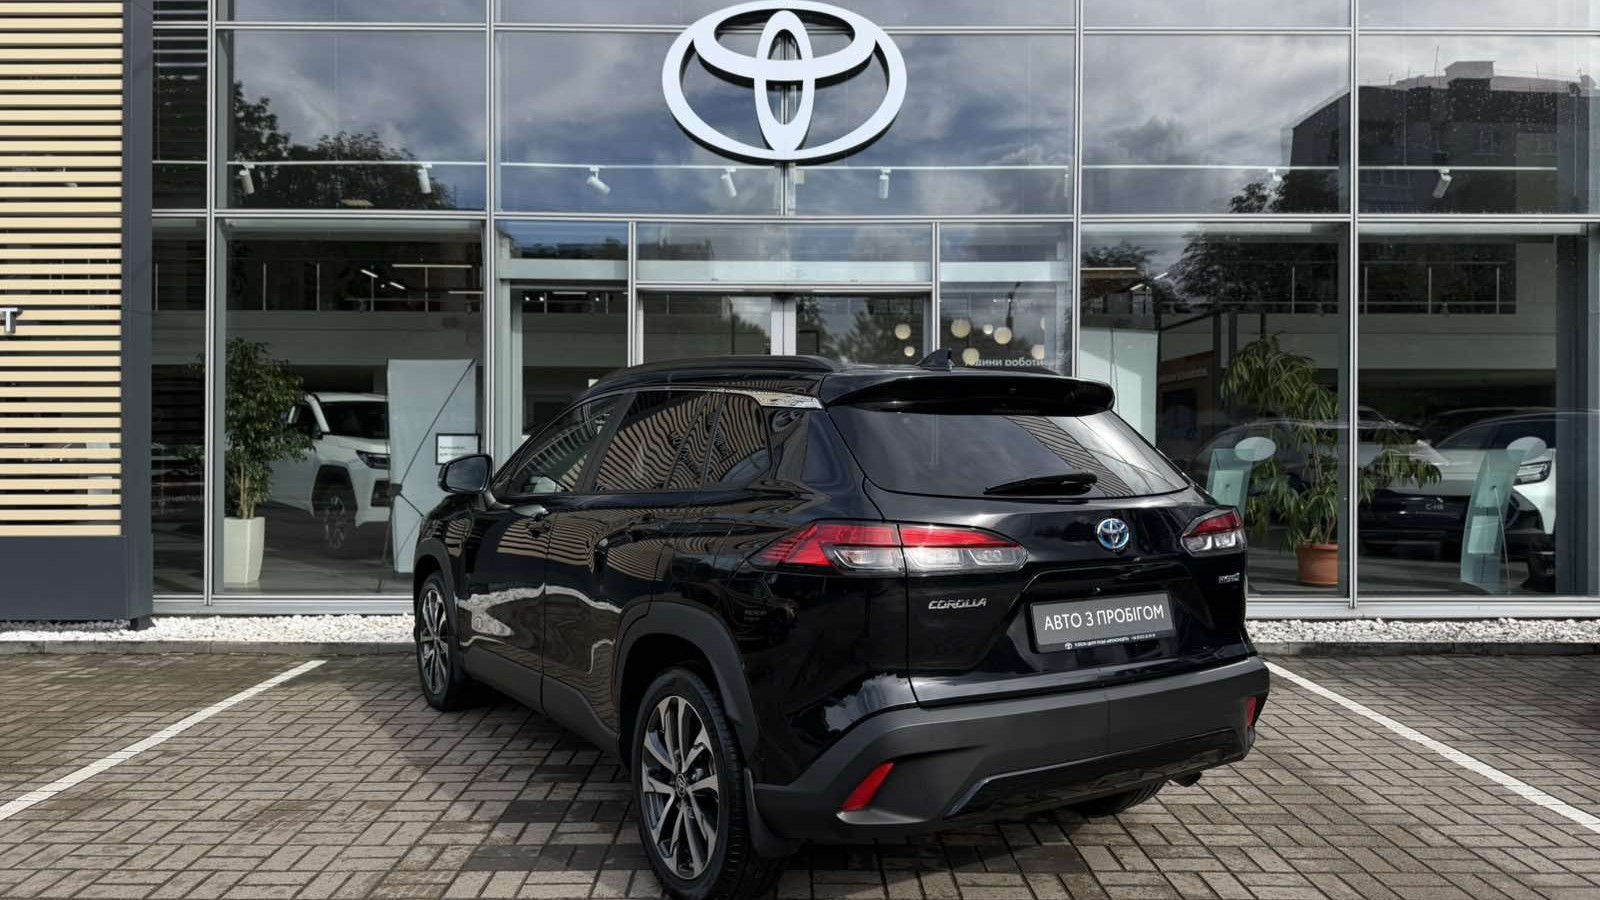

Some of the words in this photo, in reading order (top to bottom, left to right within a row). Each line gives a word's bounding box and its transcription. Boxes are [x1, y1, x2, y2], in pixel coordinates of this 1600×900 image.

[928, 598, 987, 609] COROLLA
[1044, 612, 1082, 631] АВТО
[1096, 604, 1165, 625] ПРОБІГОМ
